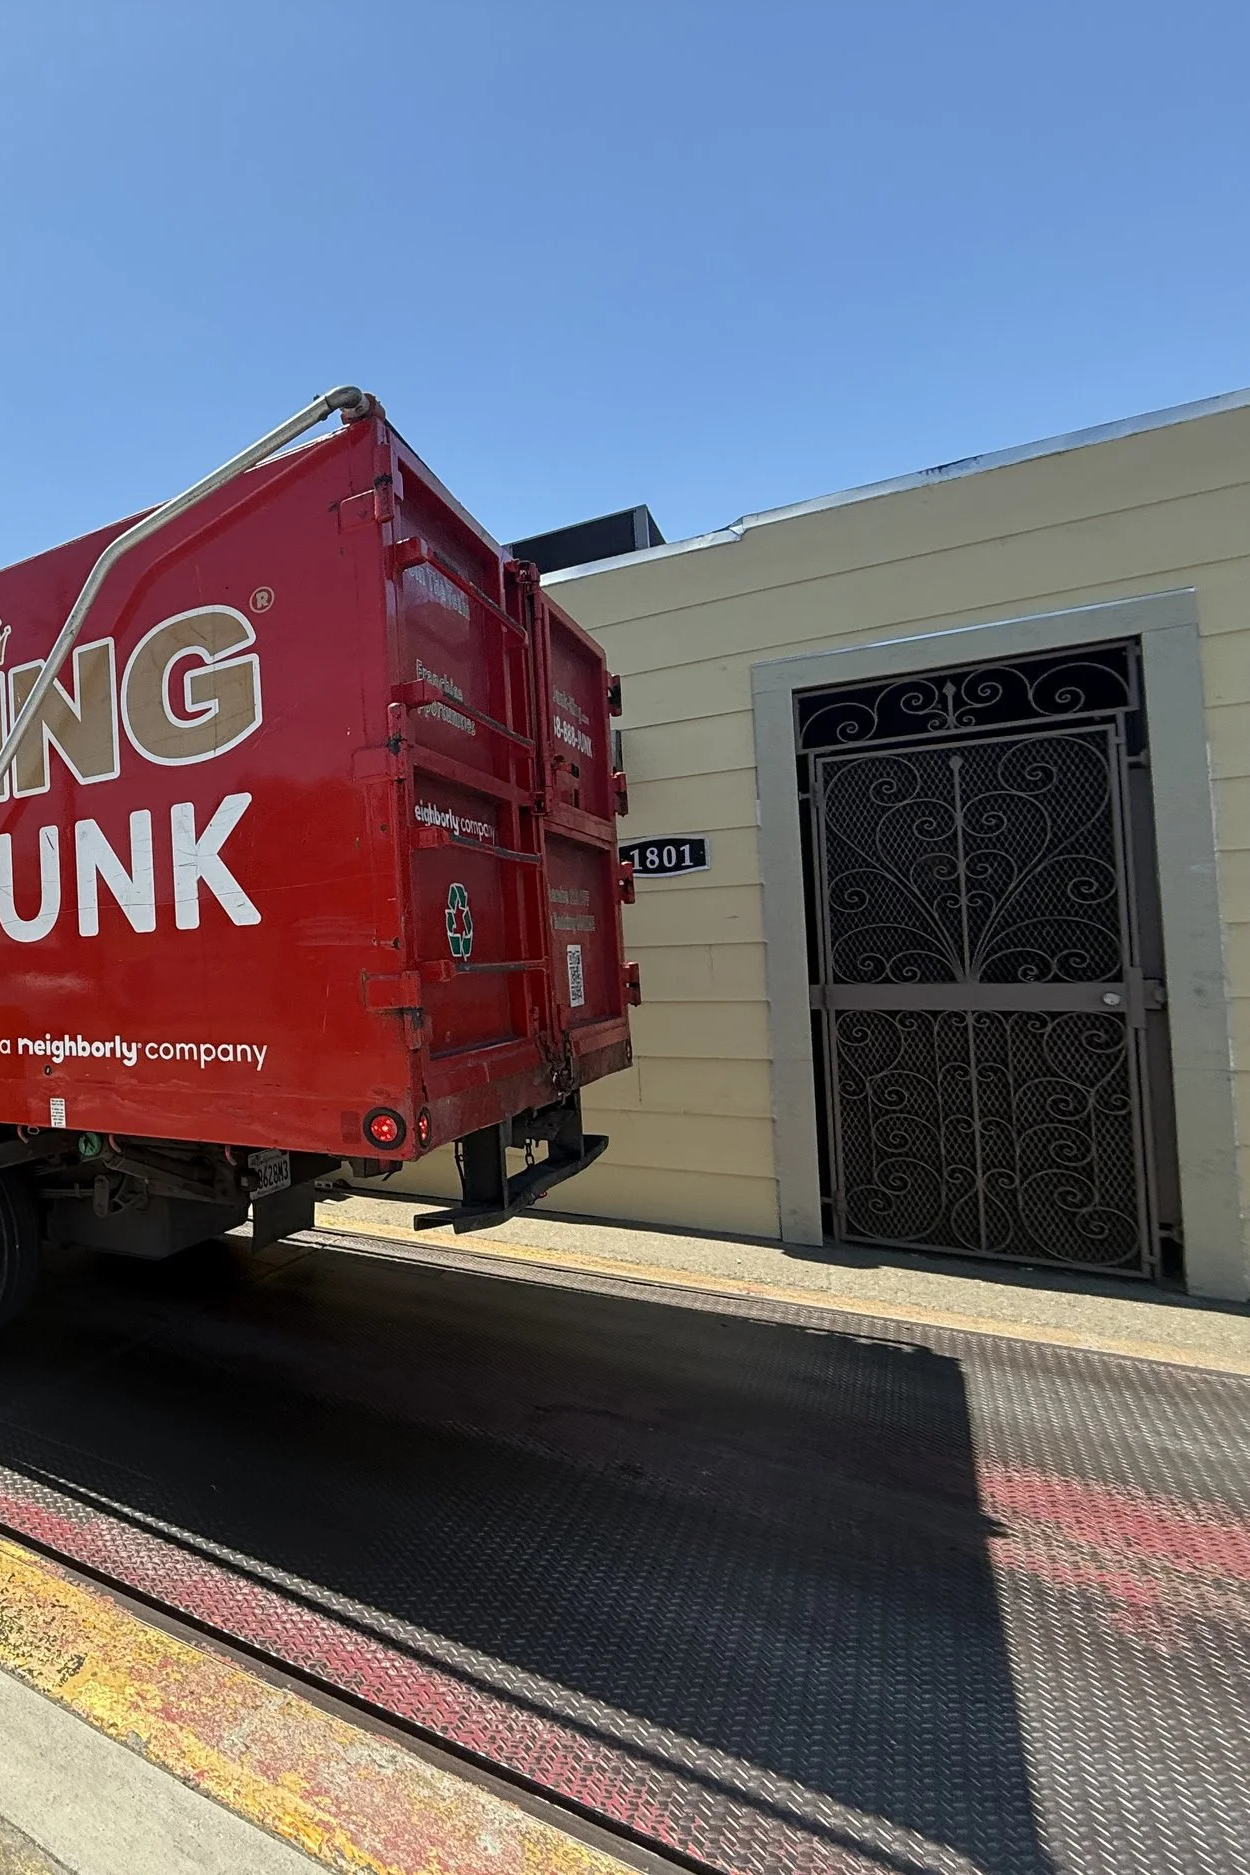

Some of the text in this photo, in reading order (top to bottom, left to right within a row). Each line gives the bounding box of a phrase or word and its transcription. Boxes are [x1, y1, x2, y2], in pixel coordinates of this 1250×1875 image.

[630, 843, 693, 870] 1801
[0, 1033, 268, 1071] a neighborly company
